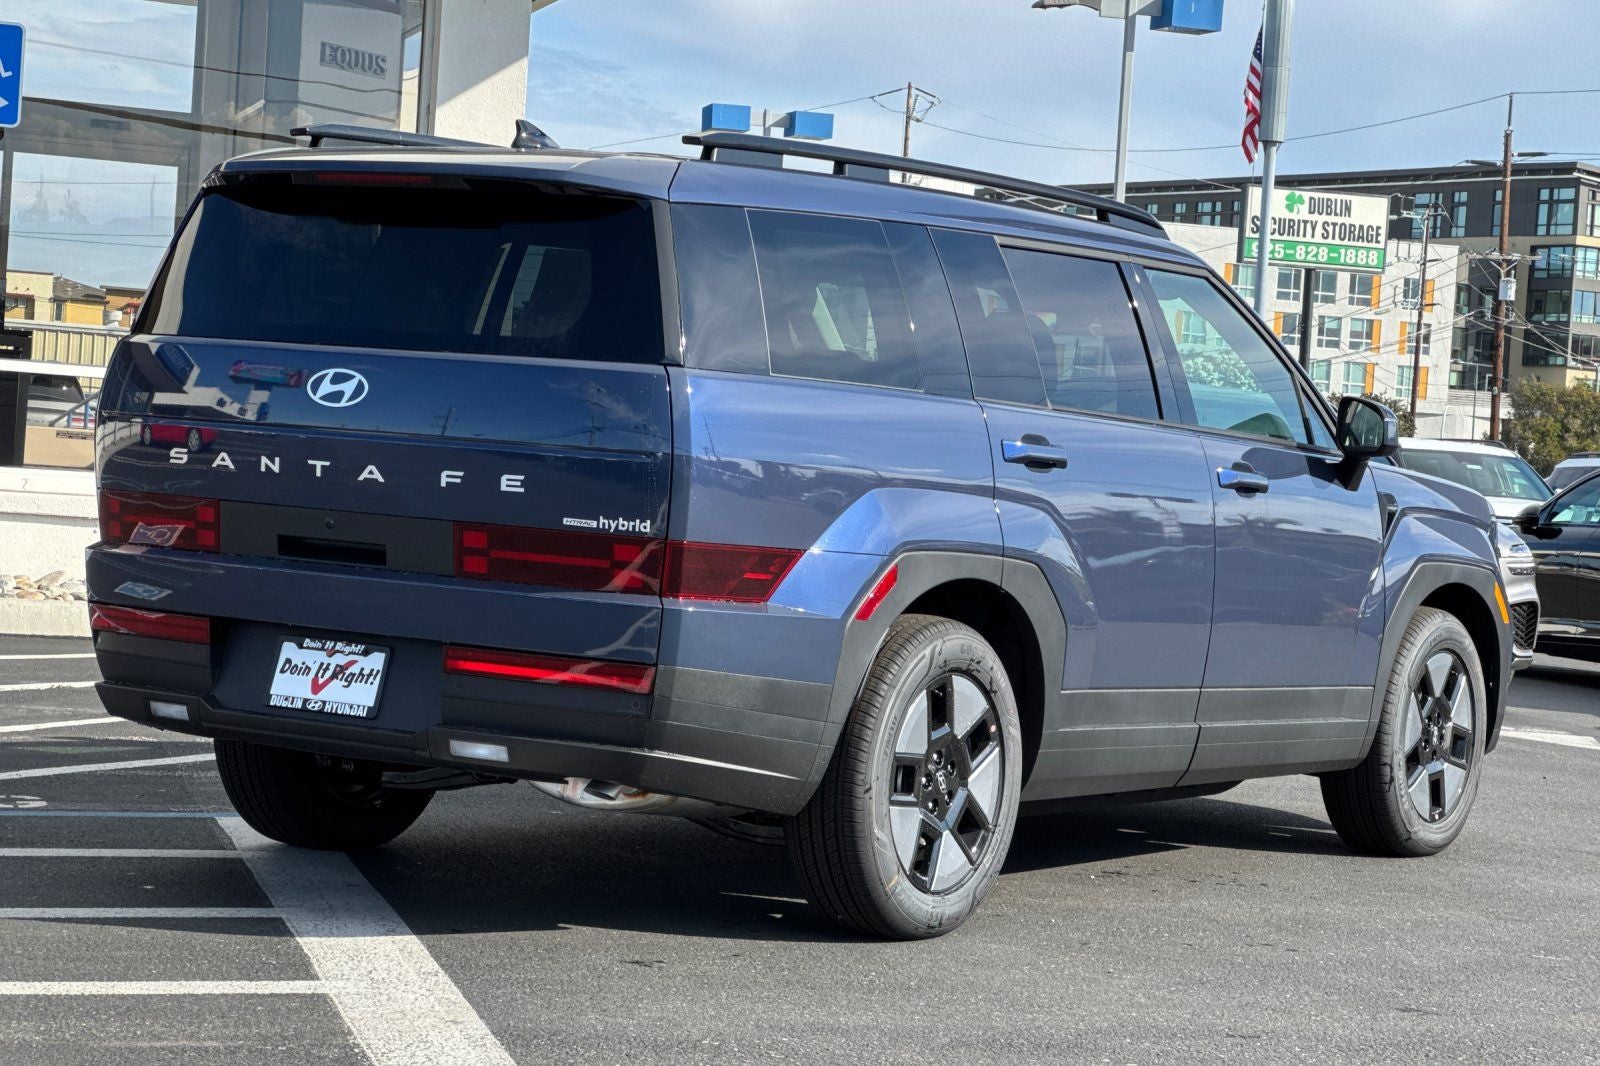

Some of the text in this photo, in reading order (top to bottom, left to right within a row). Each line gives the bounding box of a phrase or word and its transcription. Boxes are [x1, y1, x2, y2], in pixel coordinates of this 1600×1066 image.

[323, 43, 386, 77] EQUUS
[1308, 196, 1352, 218] DUBLIN
[1251, 215, 1382, 244] SCURITY STORAGE
[169, 447, 525, 493] SANTA FE
[599, 516, 651, 532] hybrid
[279, 657, 380, 688] Doin' It Right!
[270, 694, 369, 717] DUBLIN HYUNDAI
